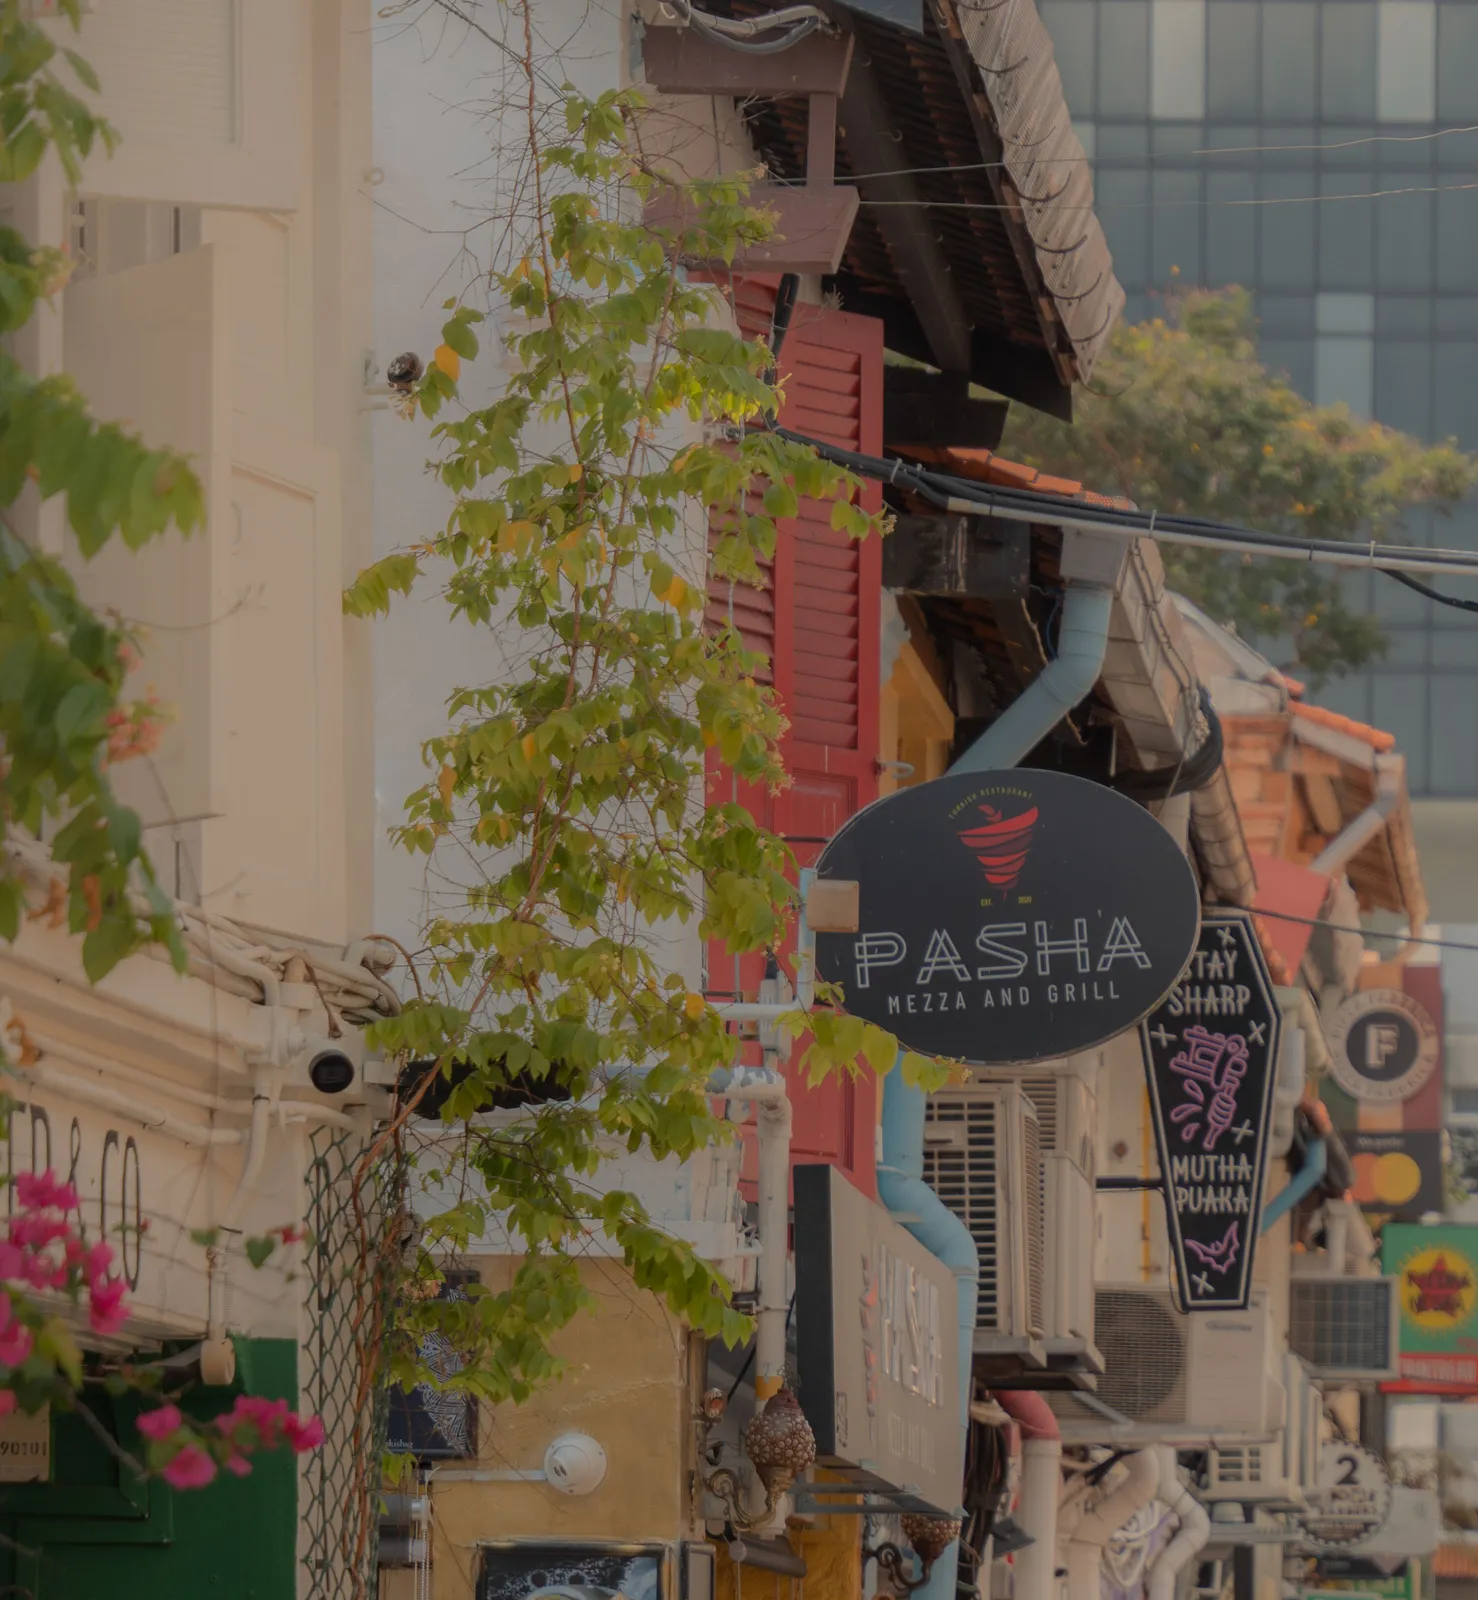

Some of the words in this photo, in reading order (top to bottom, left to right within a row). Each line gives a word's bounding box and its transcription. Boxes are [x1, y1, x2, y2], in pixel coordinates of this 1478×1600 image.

[947, 792, 977, 820] TURKISH
[980, 785, 1033, 801] RESTAURANT
[854, 915, 1152, 989] PASHA
[887, 991, 967, 1014] MEZZA
[984, 986, 1031, 1007] AND
[1047, 980, 1121, 1003] GRILL
[1166, 985, 1251, 1017] SHARP
[1365, 1023, 1400, 1069] F
[1171, 1154, 1252, 1184] MUTHA
[1176, 1184, 1250, 1215] PUAKA
[1335, 1454, 1361, 1486] 2
